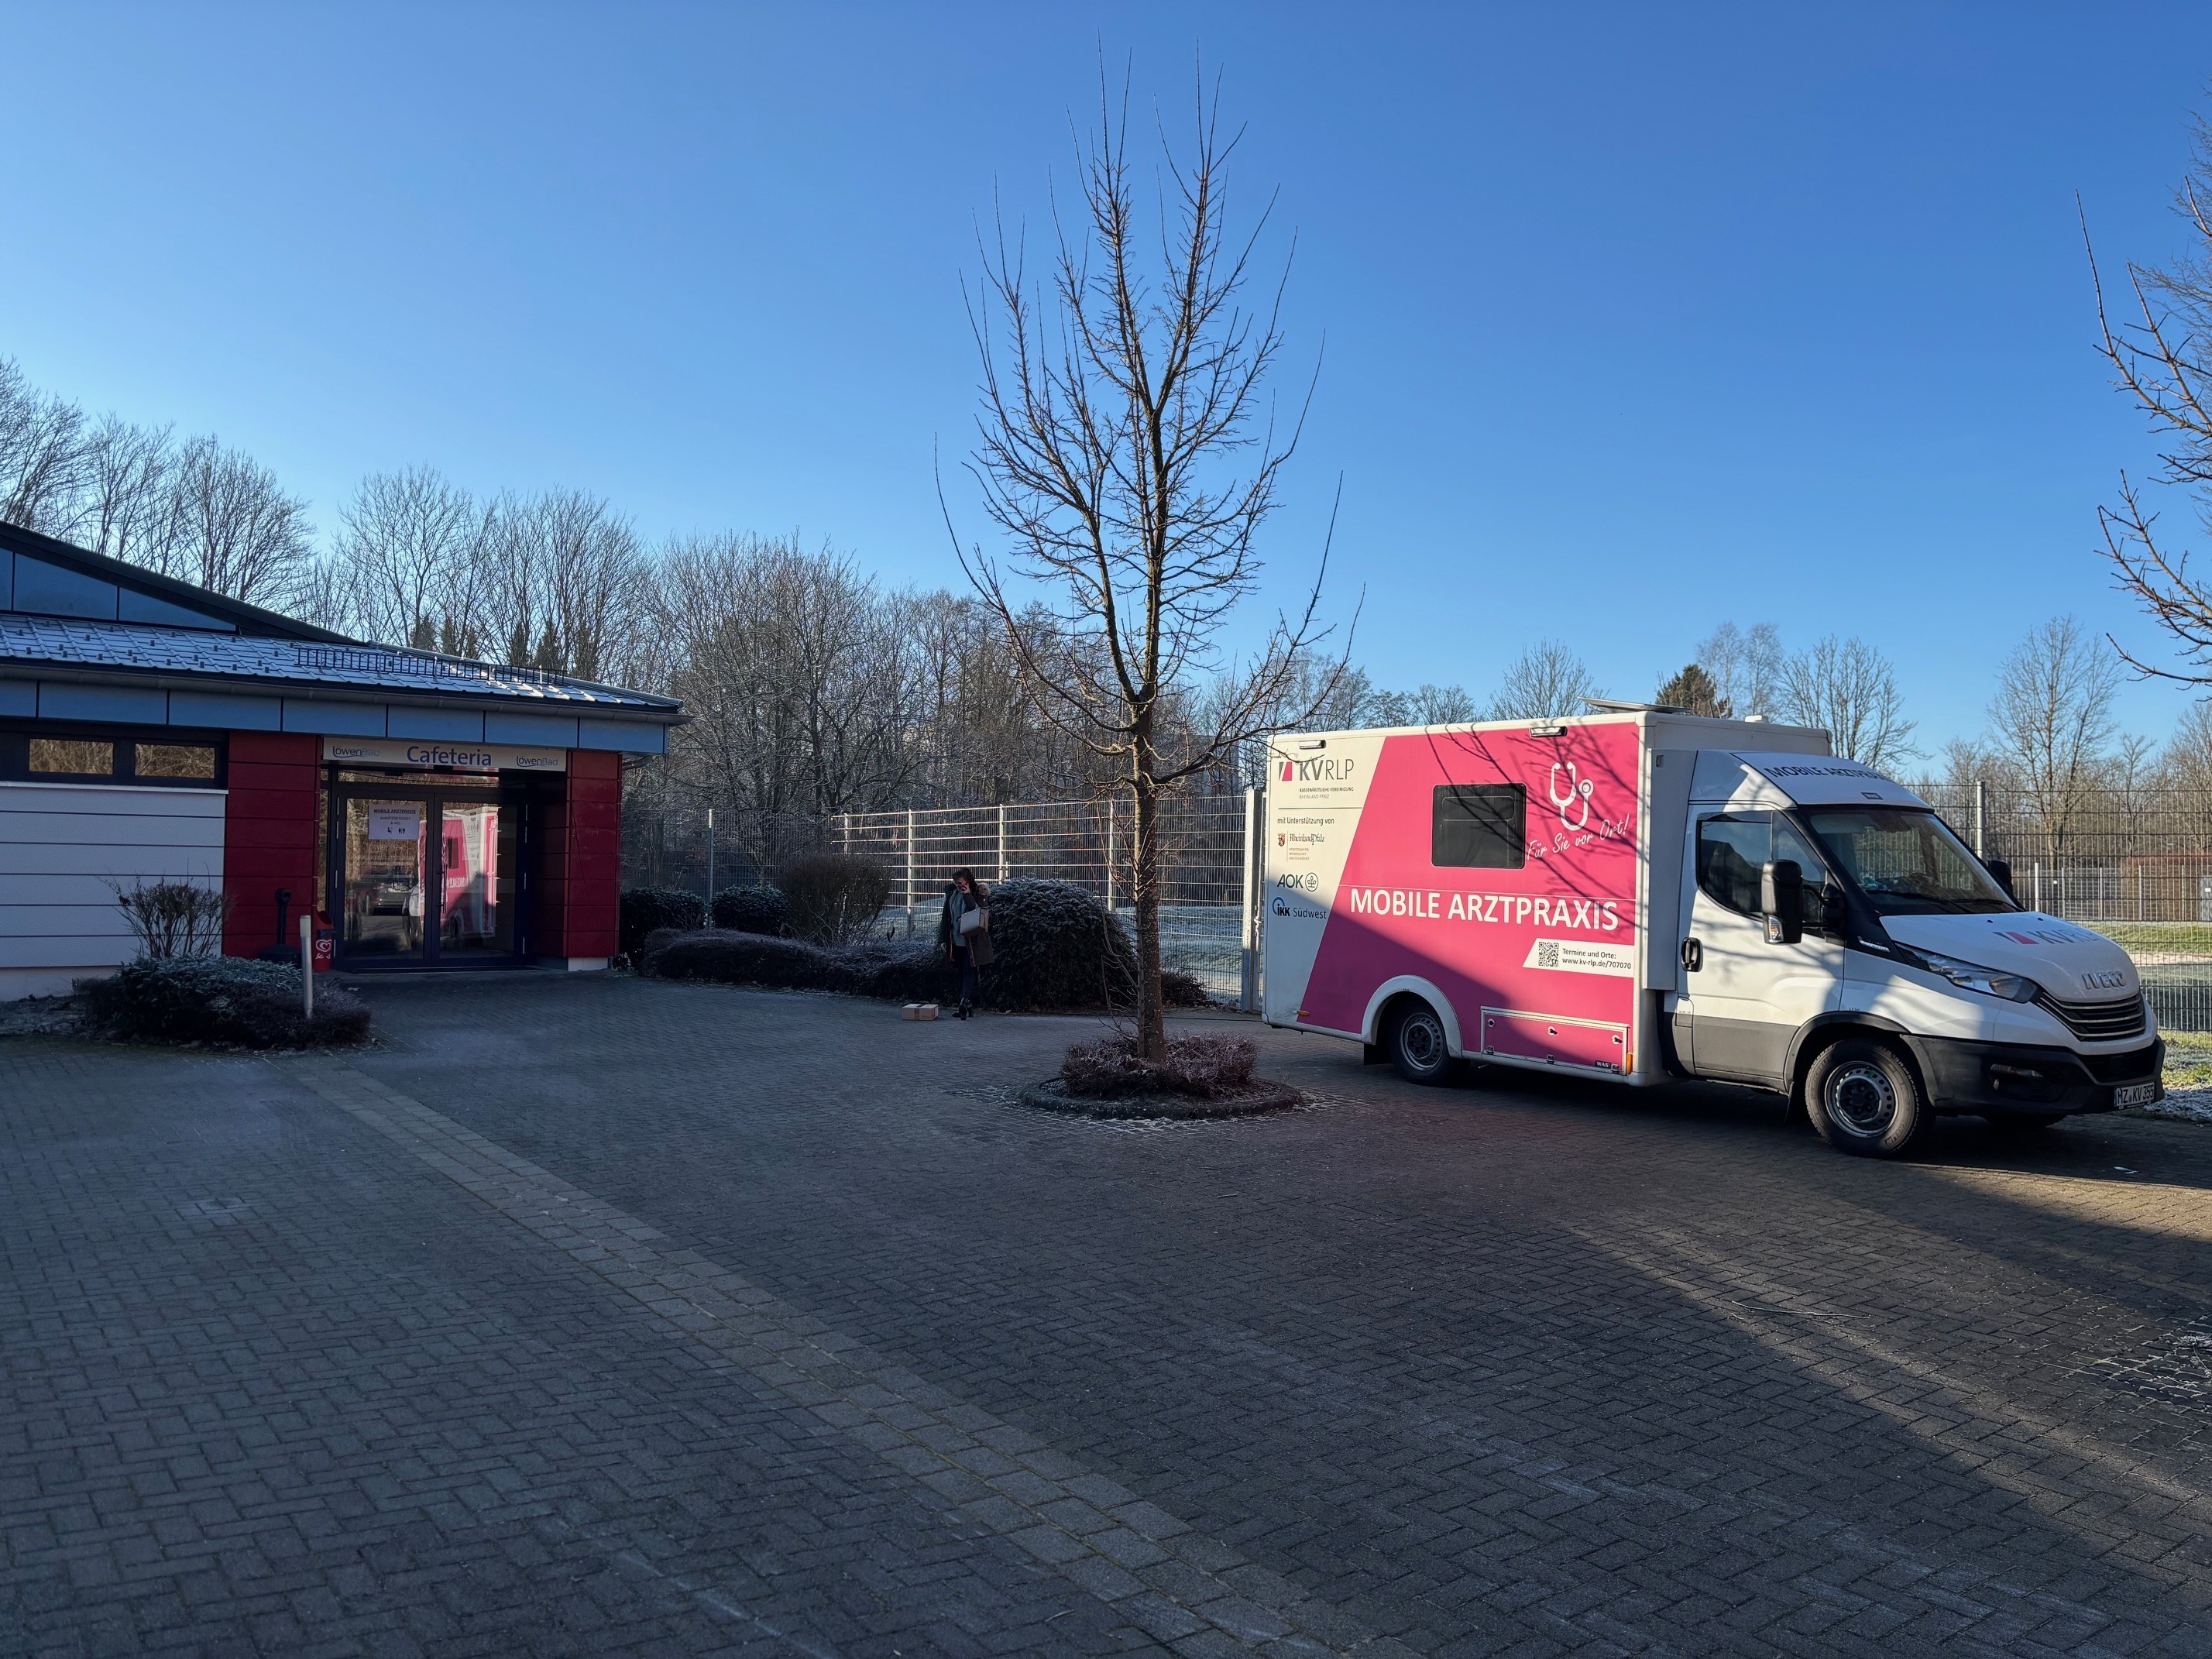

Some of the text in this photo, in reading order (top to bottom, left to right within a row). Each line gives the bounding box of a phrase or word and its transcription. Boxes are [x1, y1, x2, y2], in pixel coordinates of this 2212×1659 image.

[407, 746, 492, 766] Cafeteria
[1299, 758, 1354, 781] KVRLP
[1764, 766, 1828, 778] MOBILE
[1286, 817, 1324, 826] Unterstützung
[1527, 812, 1630, 860] Für Sie vor Ort!
[1276, 874, 1304, 888] AOK
[1293, 907, 1327, 919] Südwest
[1350, 888, 1619, 931] MOBILE ARZTPRAXIS
[1562, 948, 1586, 957] Termine
[1600, 951, 1616, 960] Orte:
[1562, 957, 1632, 969] www.kv-rlp.de/707070
[2081, 970, 2127, 990] IVECO
[2118, 1084, 2154, 1104] MZ KV 355
